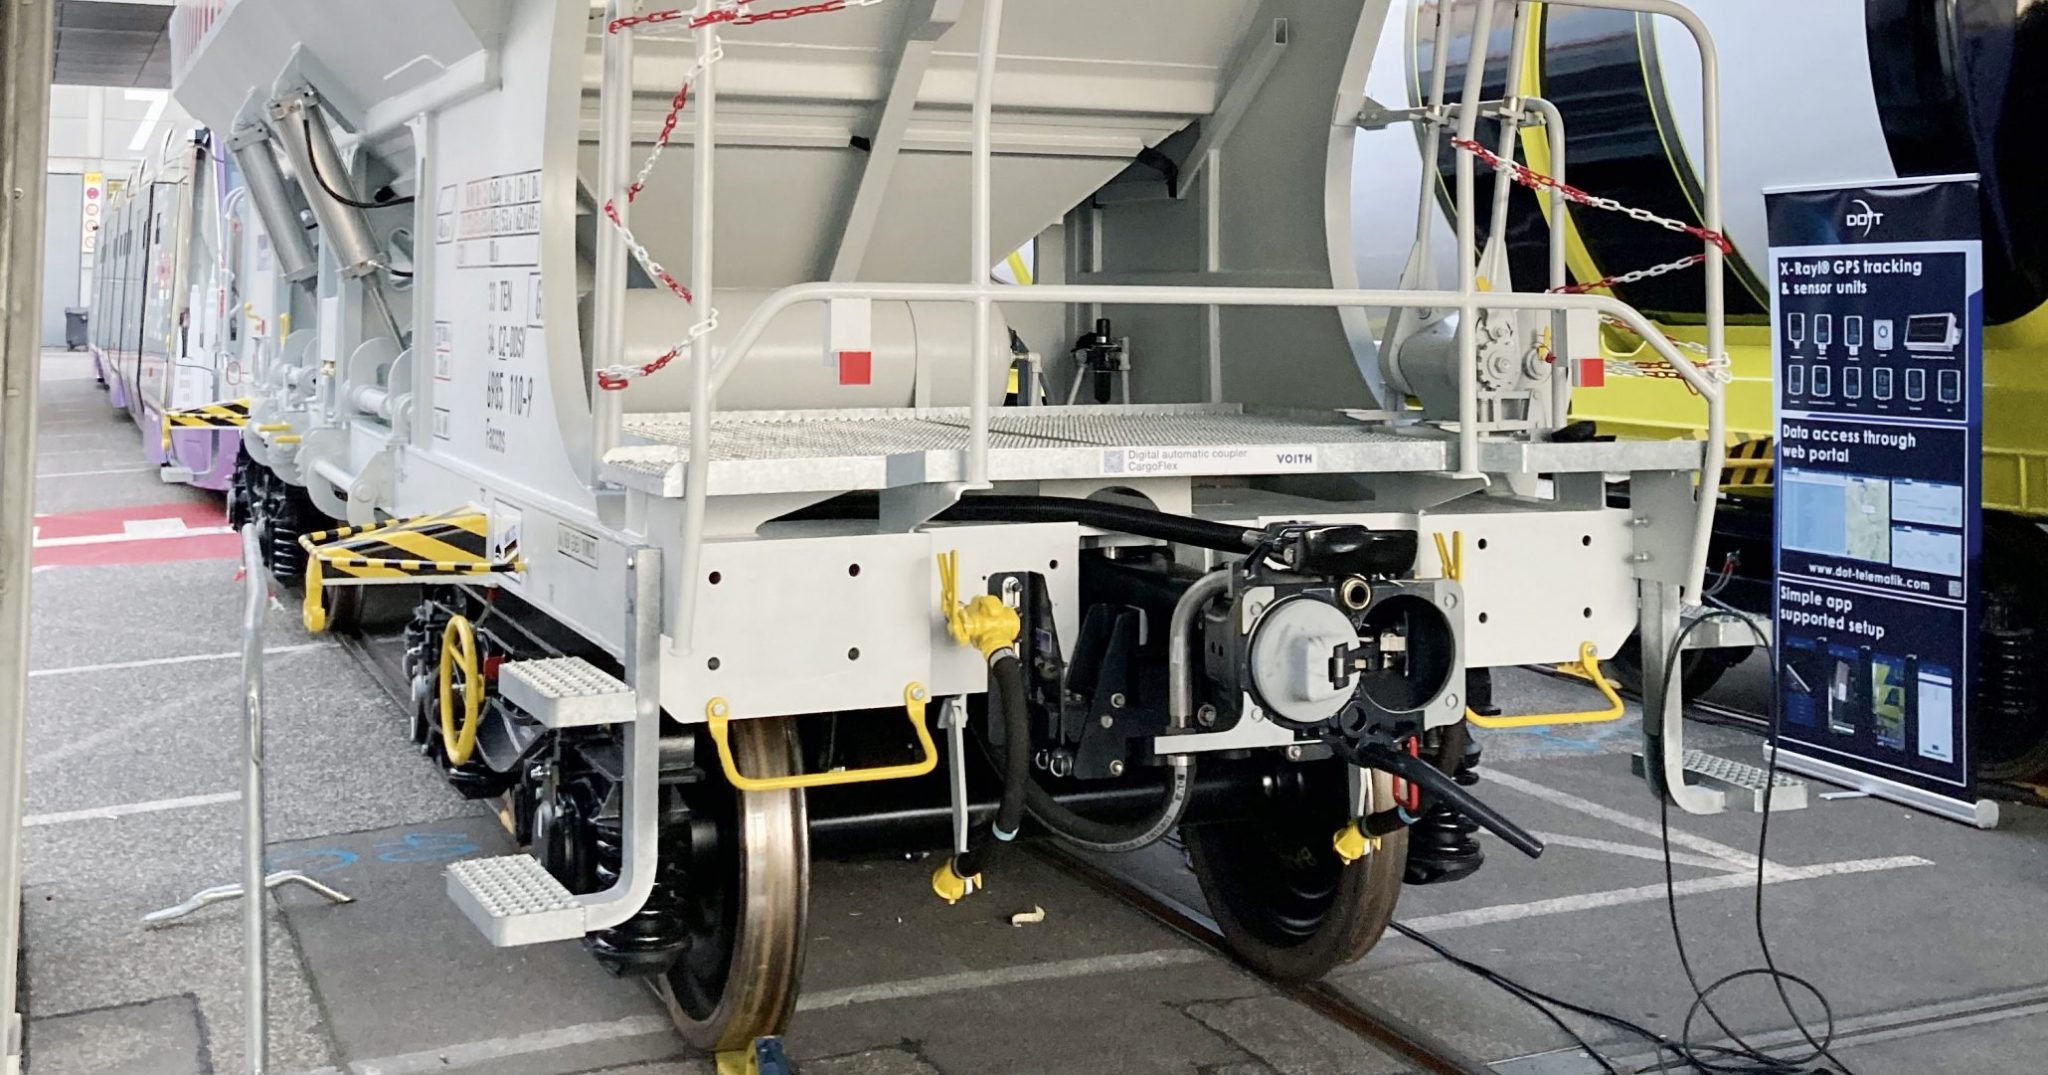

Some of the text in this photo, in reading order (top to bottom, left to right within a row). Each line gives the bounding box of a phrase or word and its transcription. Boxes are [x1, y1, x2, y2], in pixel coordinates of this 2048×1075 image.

[124, 89, 168, 151] 7
[1833, 260, 1860, 275] GPS
[1863, 258, 1923, 276] tracking
[1781, 279, 1868, 295] & sensor units
[509, 374, 533, 417] 110-9
[1782, 424, 1917, 450] Data access through
[1128, 448, 1247, 460] Digital automatic coupler
[1276, 454, 1313, 464] VOITH
[1782, 445, 1849, 463] web portal
[1128, 461, 1178, 472] CargoFlex
[1808, 563, 1931, 592] www.dot-telematik.com
[1780, 585, 1853, 613] Simple app
[1780, 608, 1885, 640] supported setup
